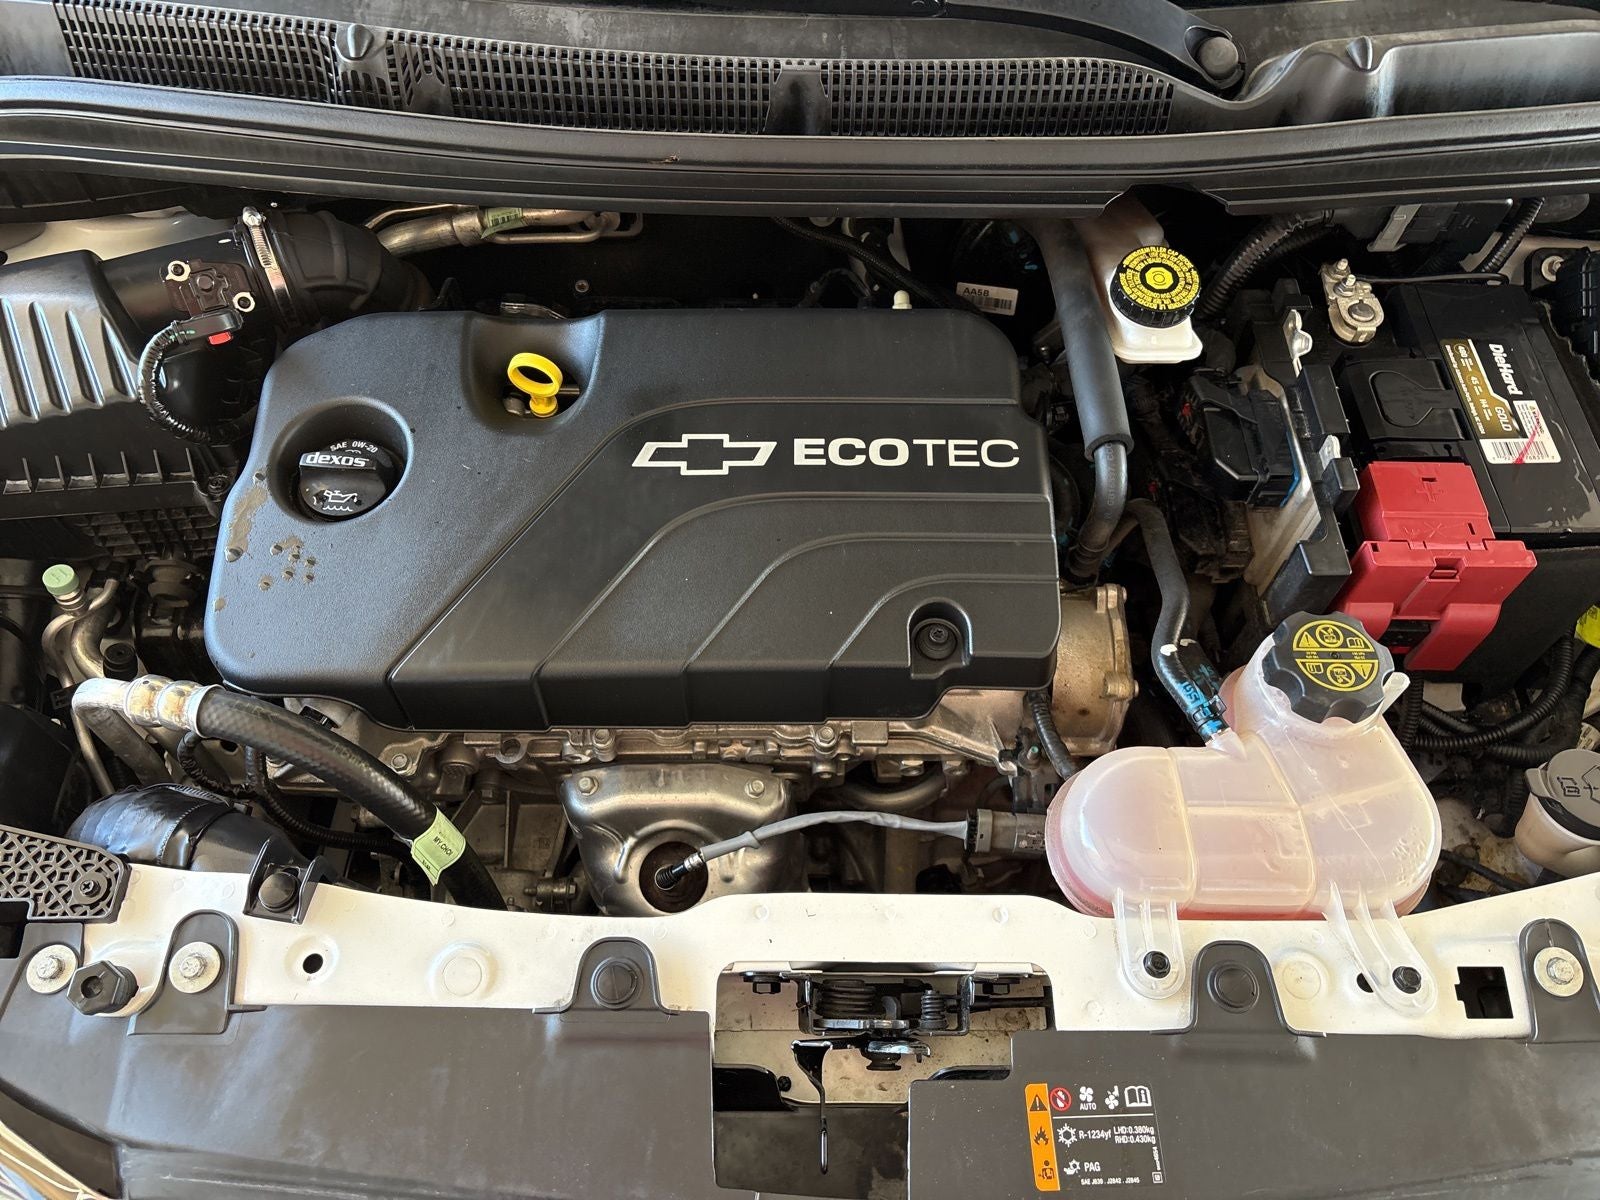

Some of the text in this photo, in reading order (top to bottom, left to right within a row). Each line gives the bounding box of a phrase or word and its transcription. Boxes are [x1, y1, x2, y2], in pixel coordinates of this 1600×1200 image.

[1488, 343, 1523, 395] DieHard
[1495, 406, 1512, 432] GOLD
[330, 440, 378, 453] SAE 0W-20
[793, 437, 1020, 468] ECOTEC
[305, 452, 369, 467] dexos
[1080, 1102, 1096, 1110] AUTO
[1078, 1129, 1112, 1140] R-1234yf
[1084, 1161, 1100, 1172] PAG
